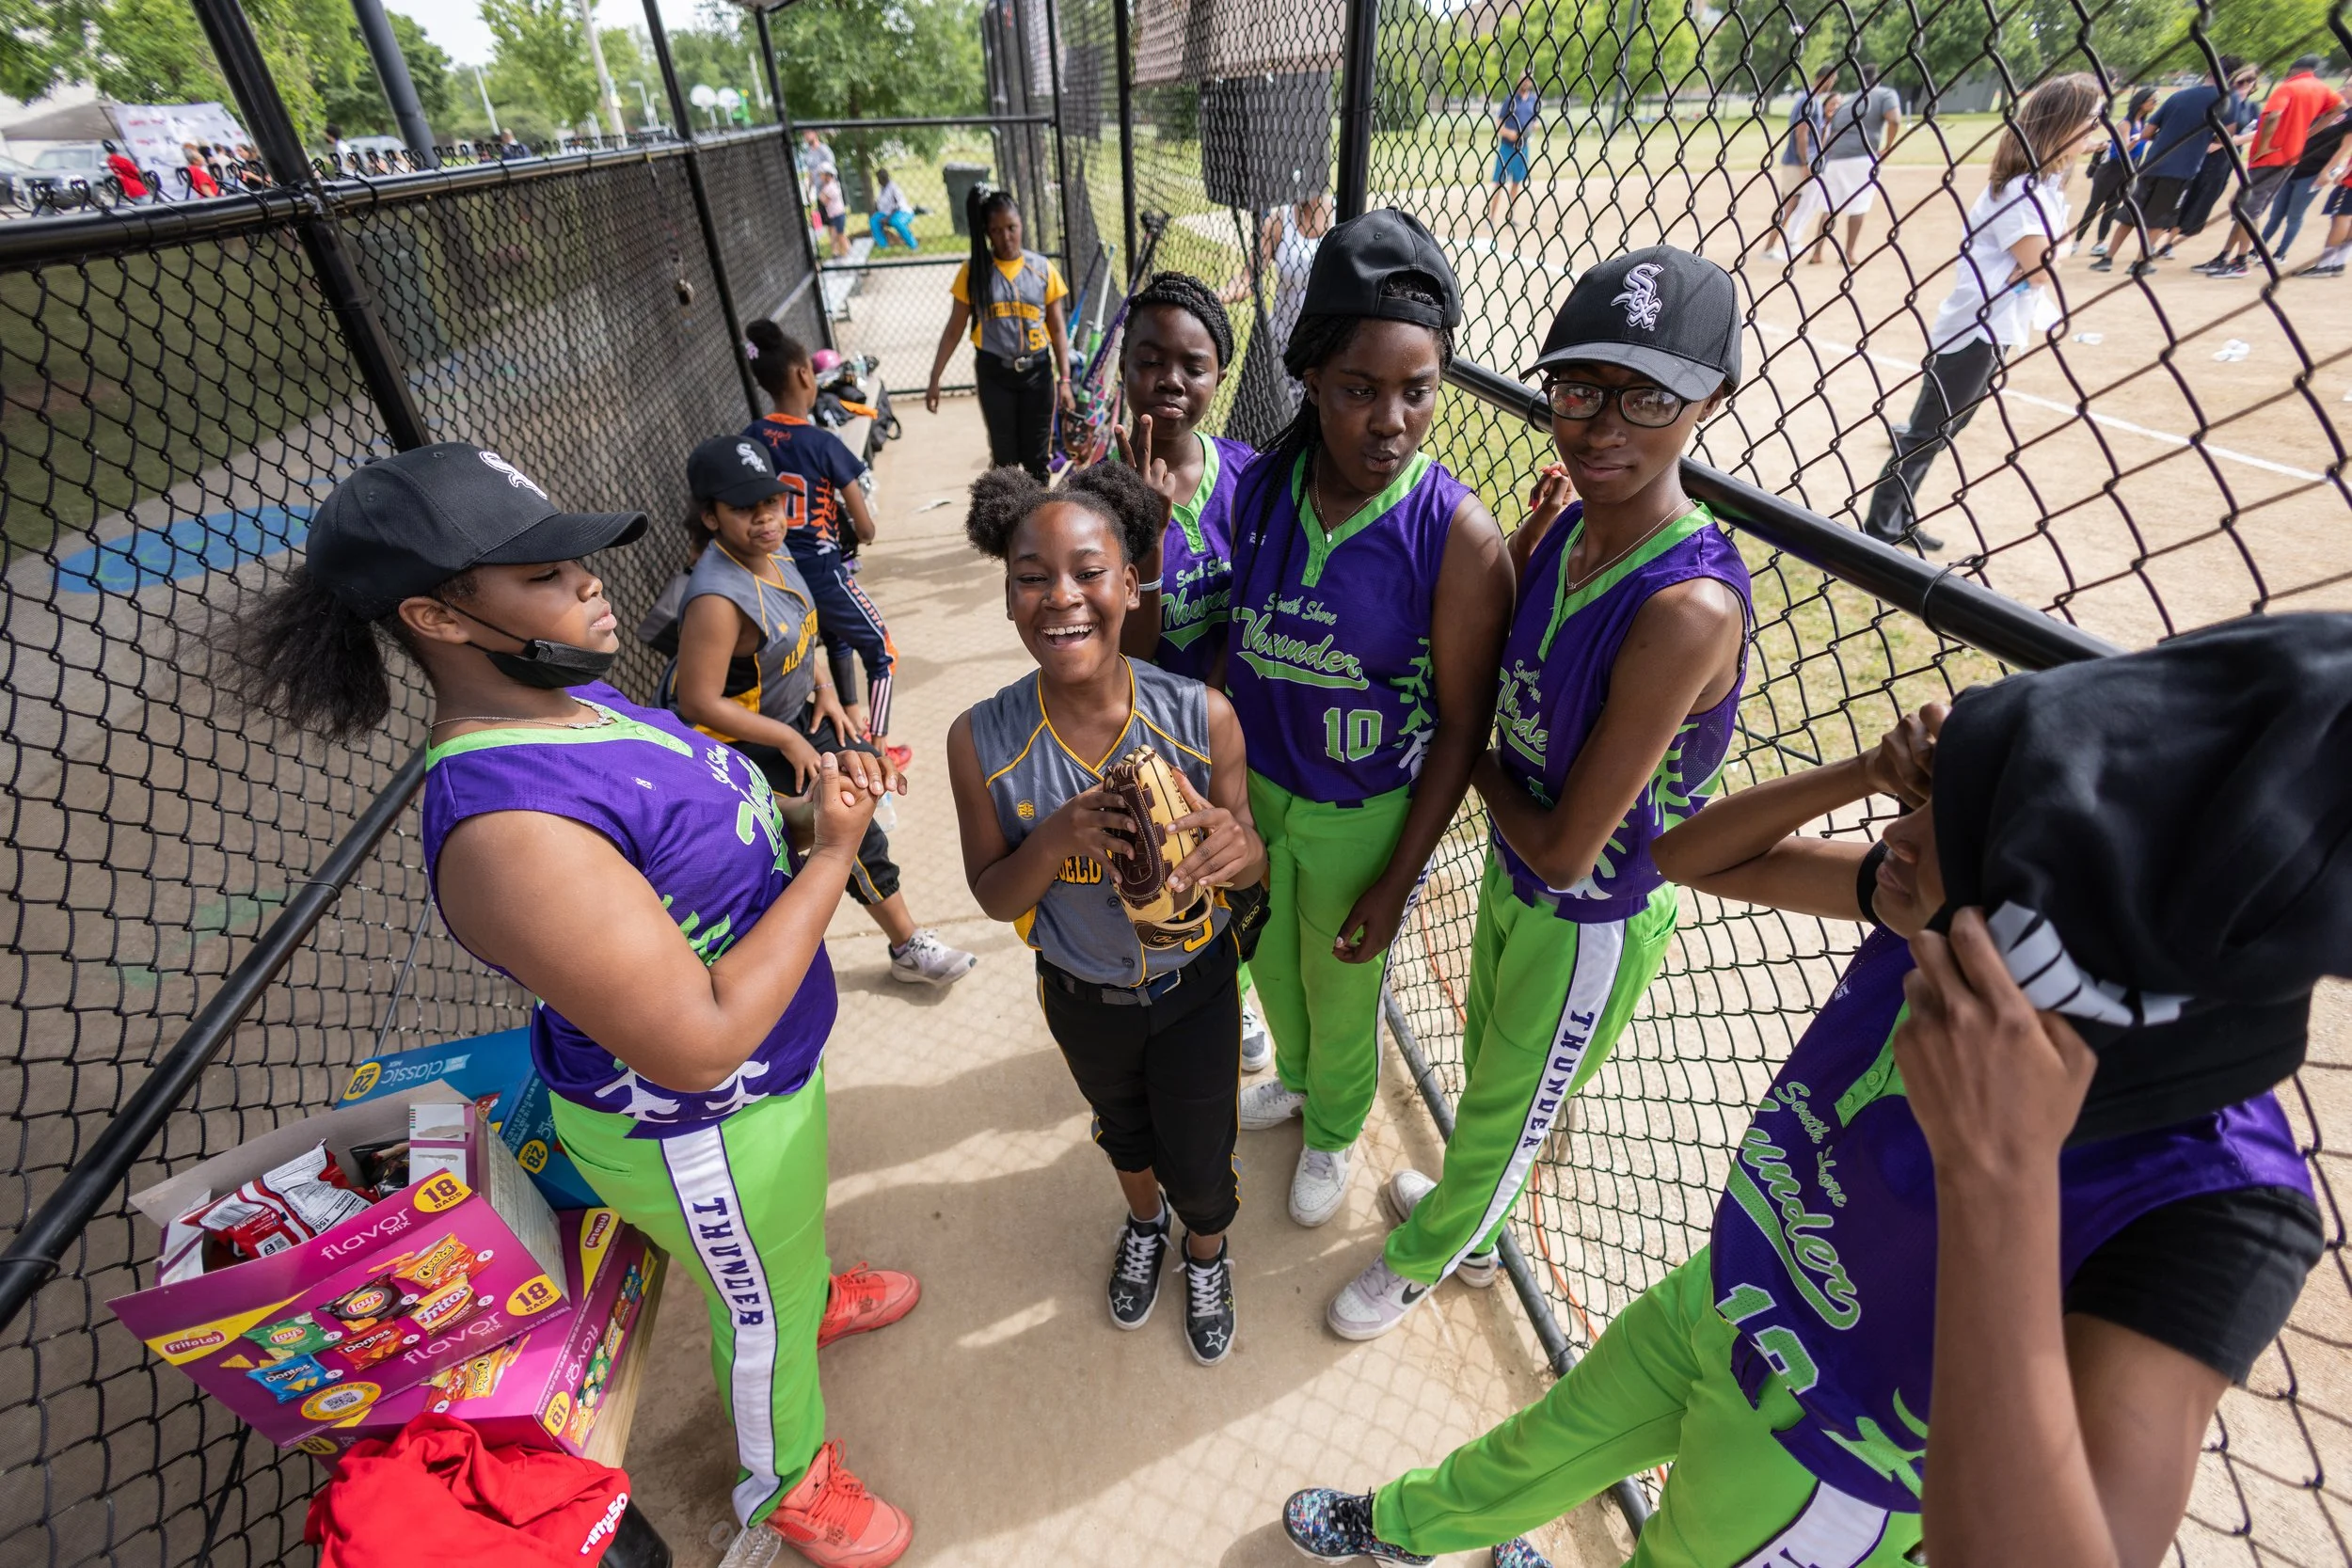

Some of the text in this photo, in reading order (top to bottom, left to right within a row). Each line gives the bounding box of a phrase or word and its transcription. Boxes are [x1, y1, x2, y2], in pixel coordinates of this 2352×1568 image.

[1263, 593, 1337, 626] South Shore
[1232, 607, 1364, 679] Thunder
[1324, 707, 1383, 763] 10
[349, 1073, 374, 1095] 28
[381, 1060, 444, 1087] classic
[1522, 1009, 1596, 1148] THUNDER
[1774, 1082, 1831, 1144] South
[527, 1146, 545, 1169] 28
[422, 1179, 458, 1204] 18
[434, 1191, 463, 1210] BAGS
[321, 1208, 409, 1260] flavor
[386, 1220, 411, 1236] MIX
[417, 1244, 456, 1280] Cheetos
[692, 1197, 765, 1326] THUNDER
[416, 1286, 469, 1325] Fritos
[516, 1282, 548, 1307] 18
[525, 1294, 553, 1312] BAGS
[343, 1328, 391, 1354] Doritos
[403, 1311, 500, 1365] flavor
[481, 1323, 503, 1337] MIX
[568, 1323, 599, 1391] flavor
[264, 1363, 312, 1383] Doritos
[551, 1403, 566, 1428] 18
